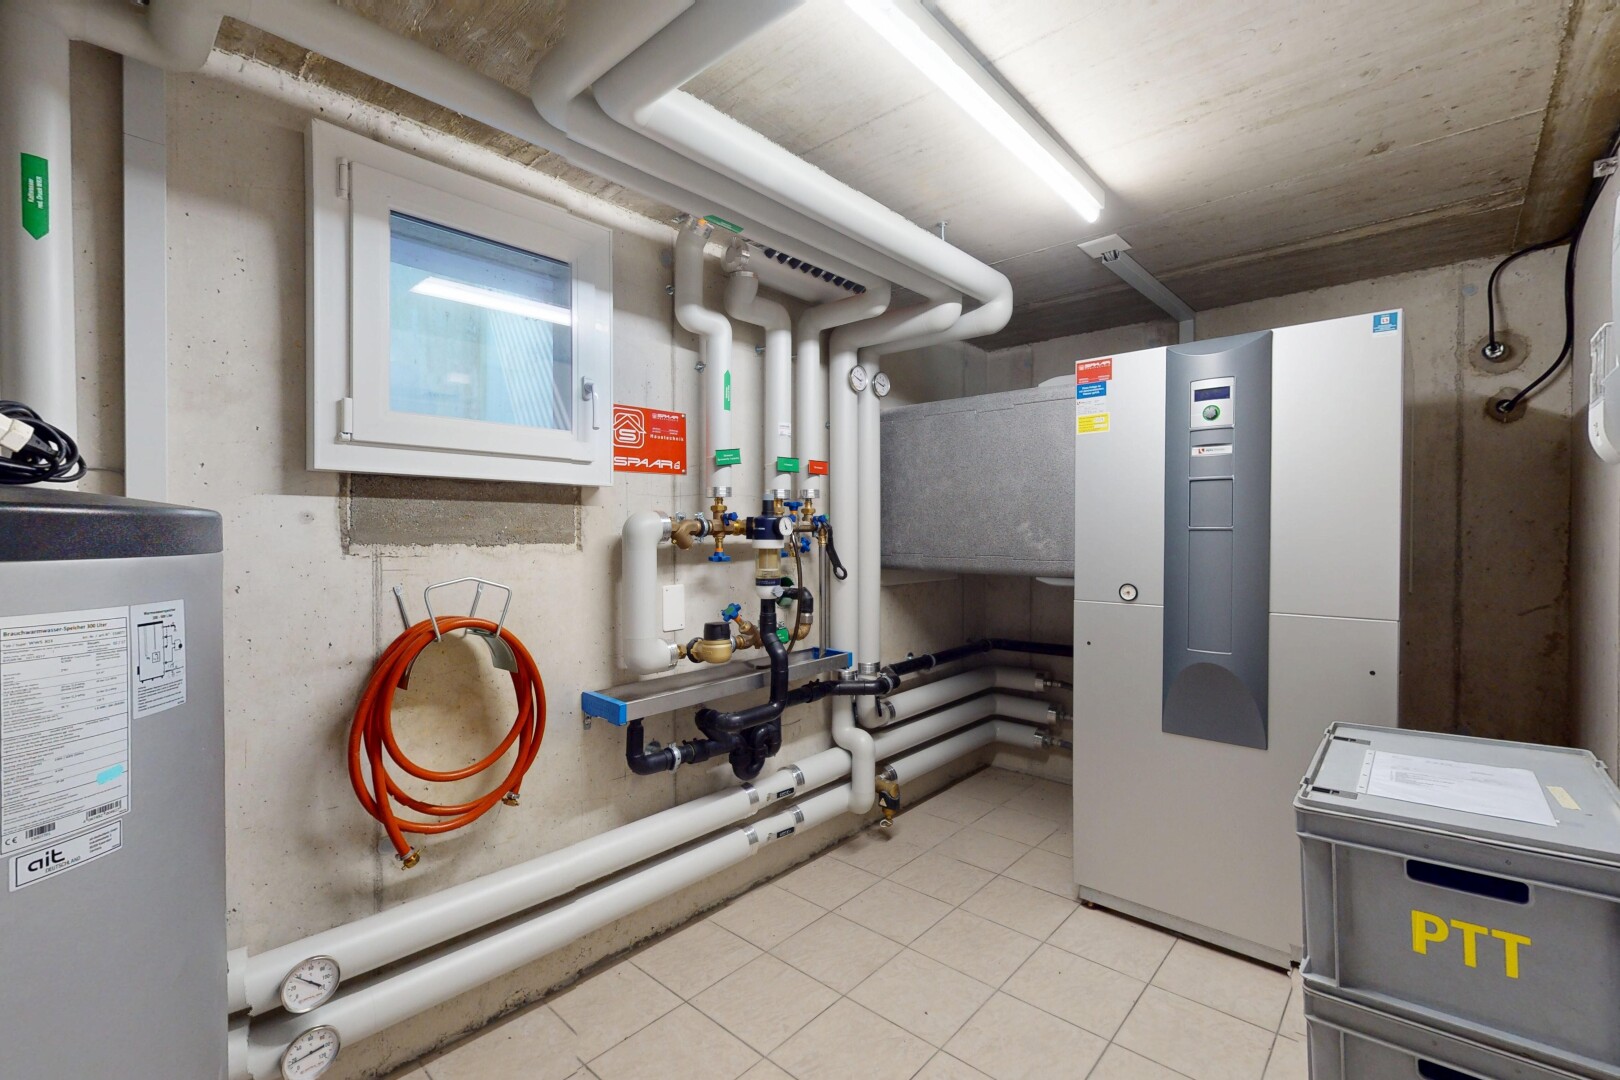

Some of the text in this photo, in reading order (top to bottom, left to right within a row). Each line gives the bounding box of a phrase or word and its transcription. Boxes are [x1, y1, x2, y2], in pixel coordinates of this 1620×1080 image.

[614, 456, 673, 469] SPAAR
[27, 849, 65, 872] ait
[45, 856, 81, 873] DEUTSCHLAND
[1411, 909, 1532, 979] PTT
